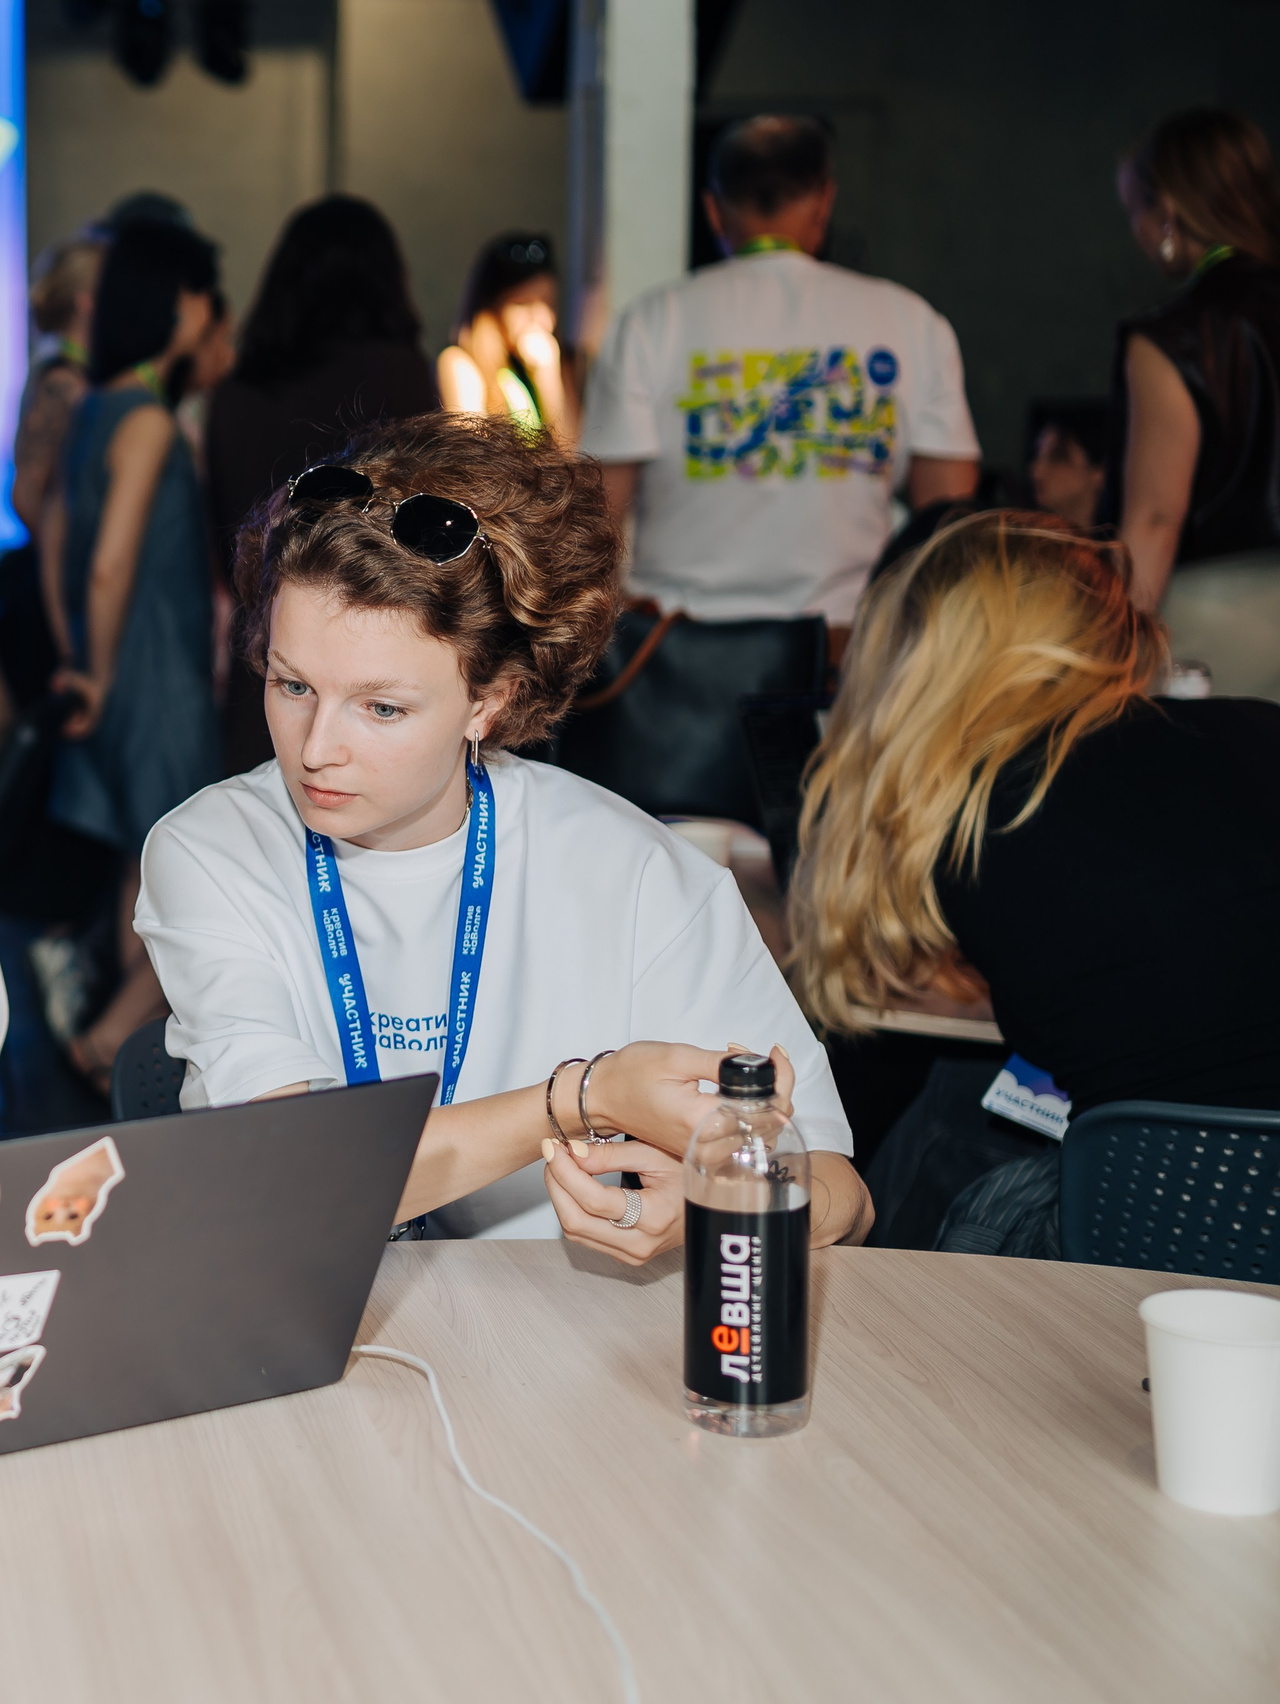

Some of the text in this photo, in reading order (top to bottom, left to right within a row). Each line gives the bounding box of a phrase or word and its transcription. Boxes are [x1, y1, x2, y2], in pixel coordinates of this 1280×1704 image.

[312, 832, 331, 893] СТНИК
[472, 790, 488, 889] УЧАСТНИК
[330, 907, 348, 956] креатив
[462, 905, 475, 955] креатив
[338, 973, 368, 1069] УЧАСТНИК
[452, 970, 471, 1068] УЧАСТНИК
